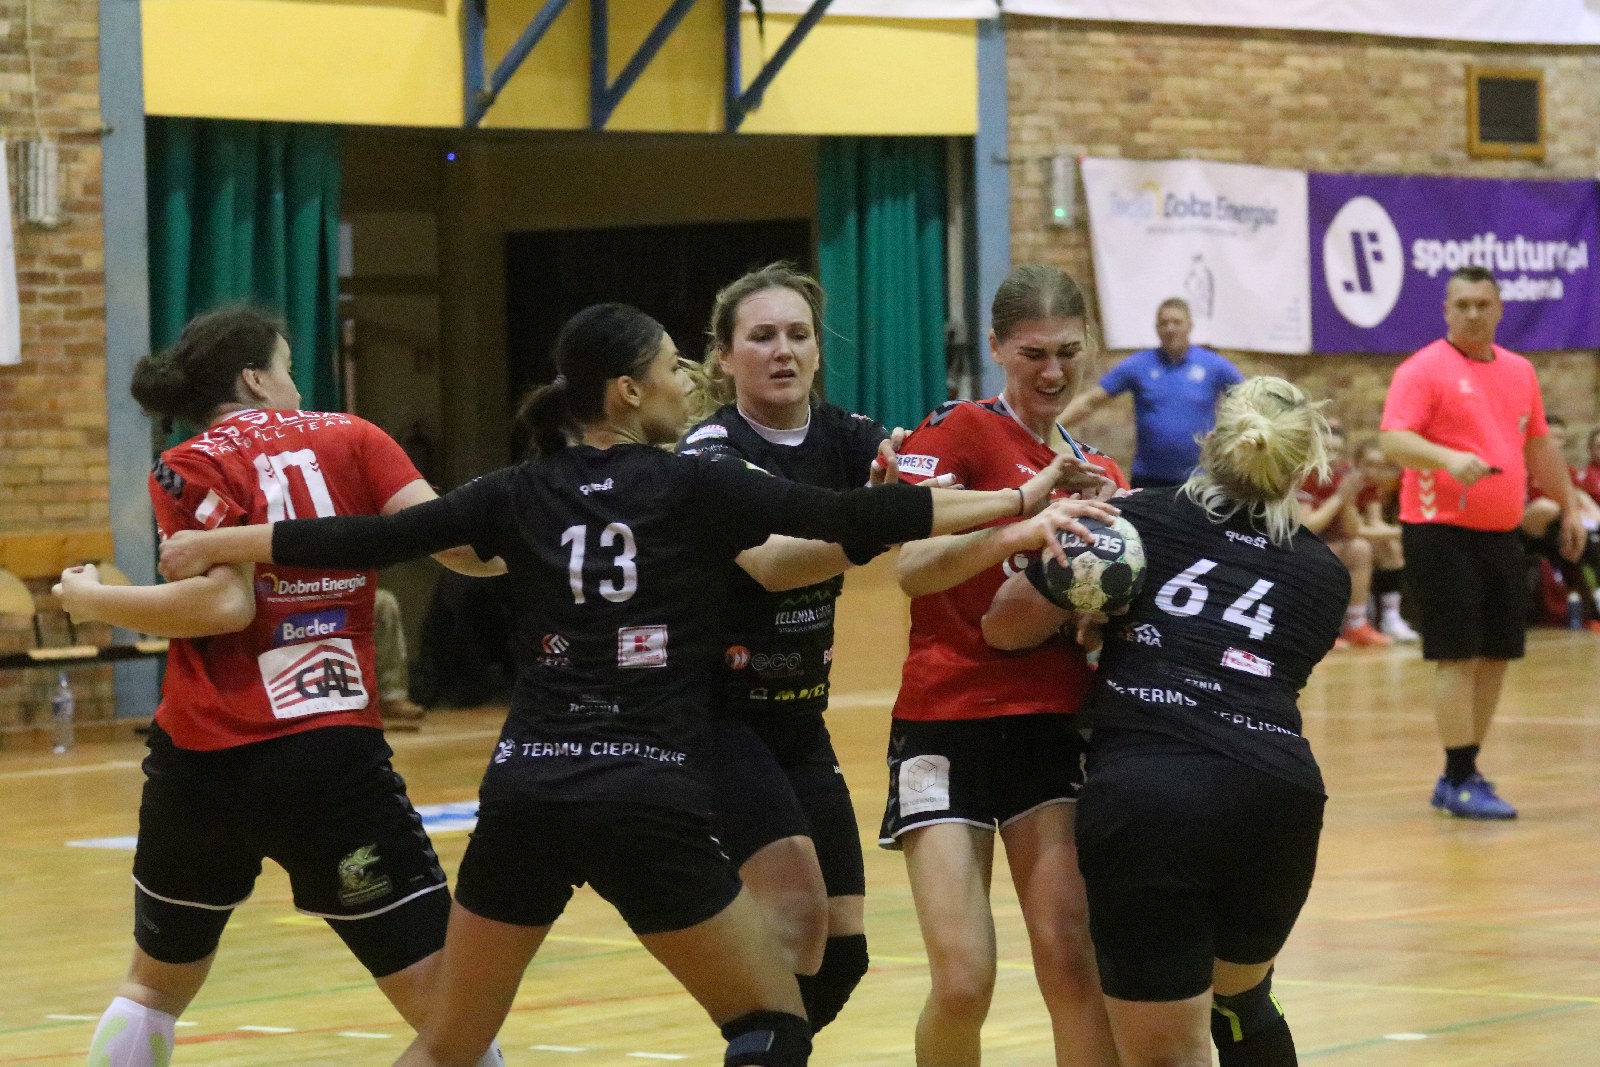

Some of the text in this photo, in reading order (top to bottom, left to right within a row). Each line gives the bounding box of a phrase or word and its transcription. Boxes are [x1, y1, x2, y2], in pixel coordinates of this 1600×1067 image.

[294, 419, 352, 433] TEAM
[1225, 530, 1268, 550] quest
[560, 522, 638, 604] 13
[277, 573, 366, 595] Dobra Energia
[1154, 558, 1276, 641] 64
[751, 652, 802, 671] eco
[521, 741, 687, 766] TERMY CIEPLICKIE
